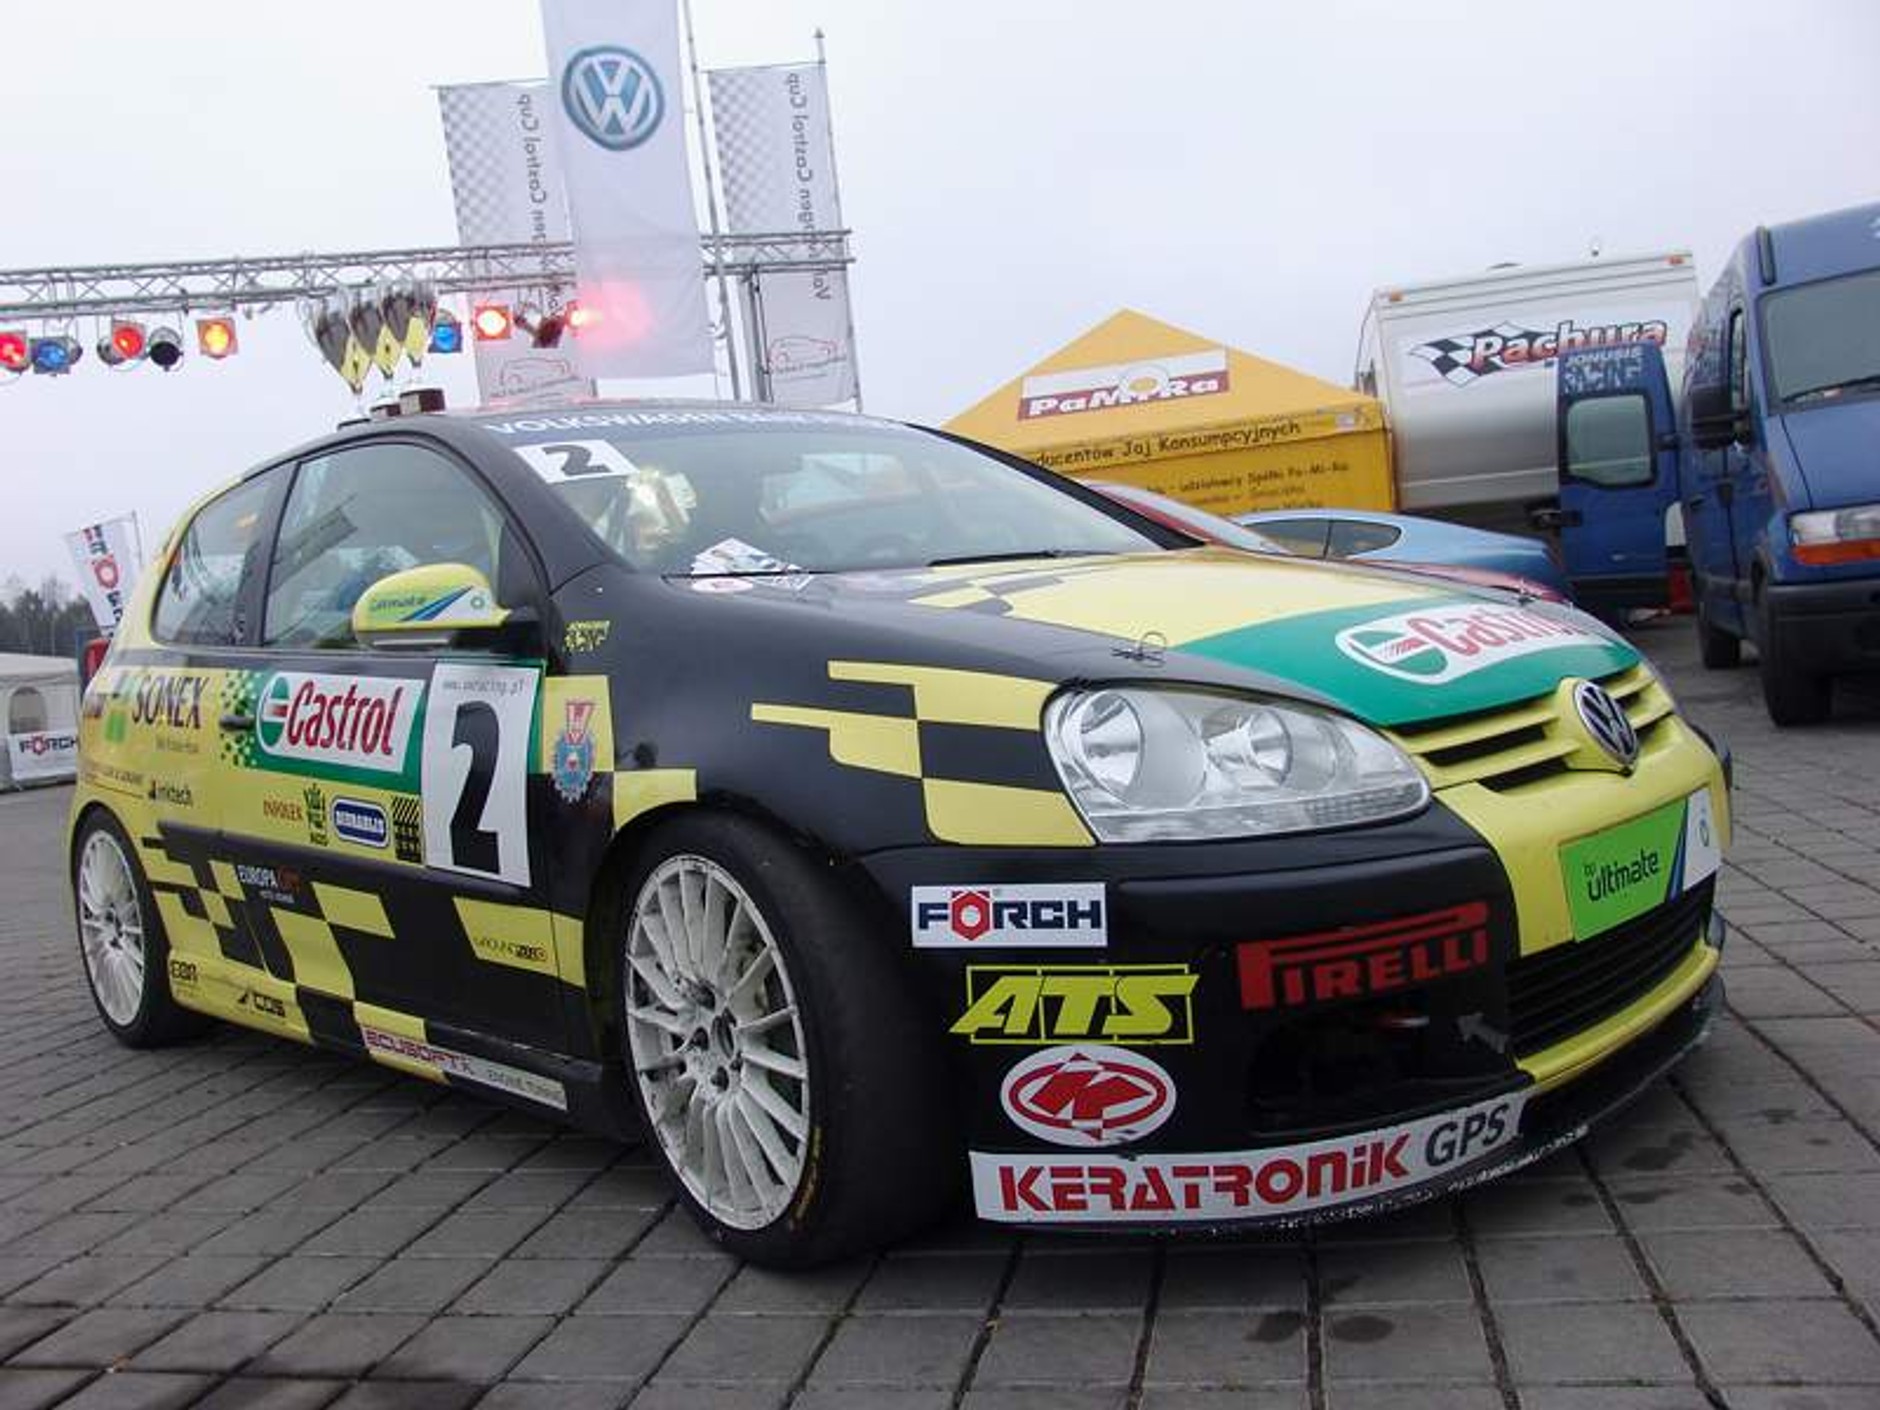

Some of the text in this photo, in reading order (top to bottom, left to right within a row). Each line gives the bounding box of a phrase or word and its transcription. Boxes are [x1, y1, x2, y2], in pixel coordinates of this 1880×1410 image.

[1472, 320, 1668, 371] Pachura
[544, 444, 611, 477] 2
[132, 675, 211, 730] SONEX
[287, 679, 404, 757] Castrol
[451, 701, 502, 875] 2
[918, 890, 1102, 942] FÖRCH
[1237, 901, 1489, 1010] PIRELLI
[948, 974, 1200, 1035] ATS
[1426, 1101, 1511, 1168] GPS
